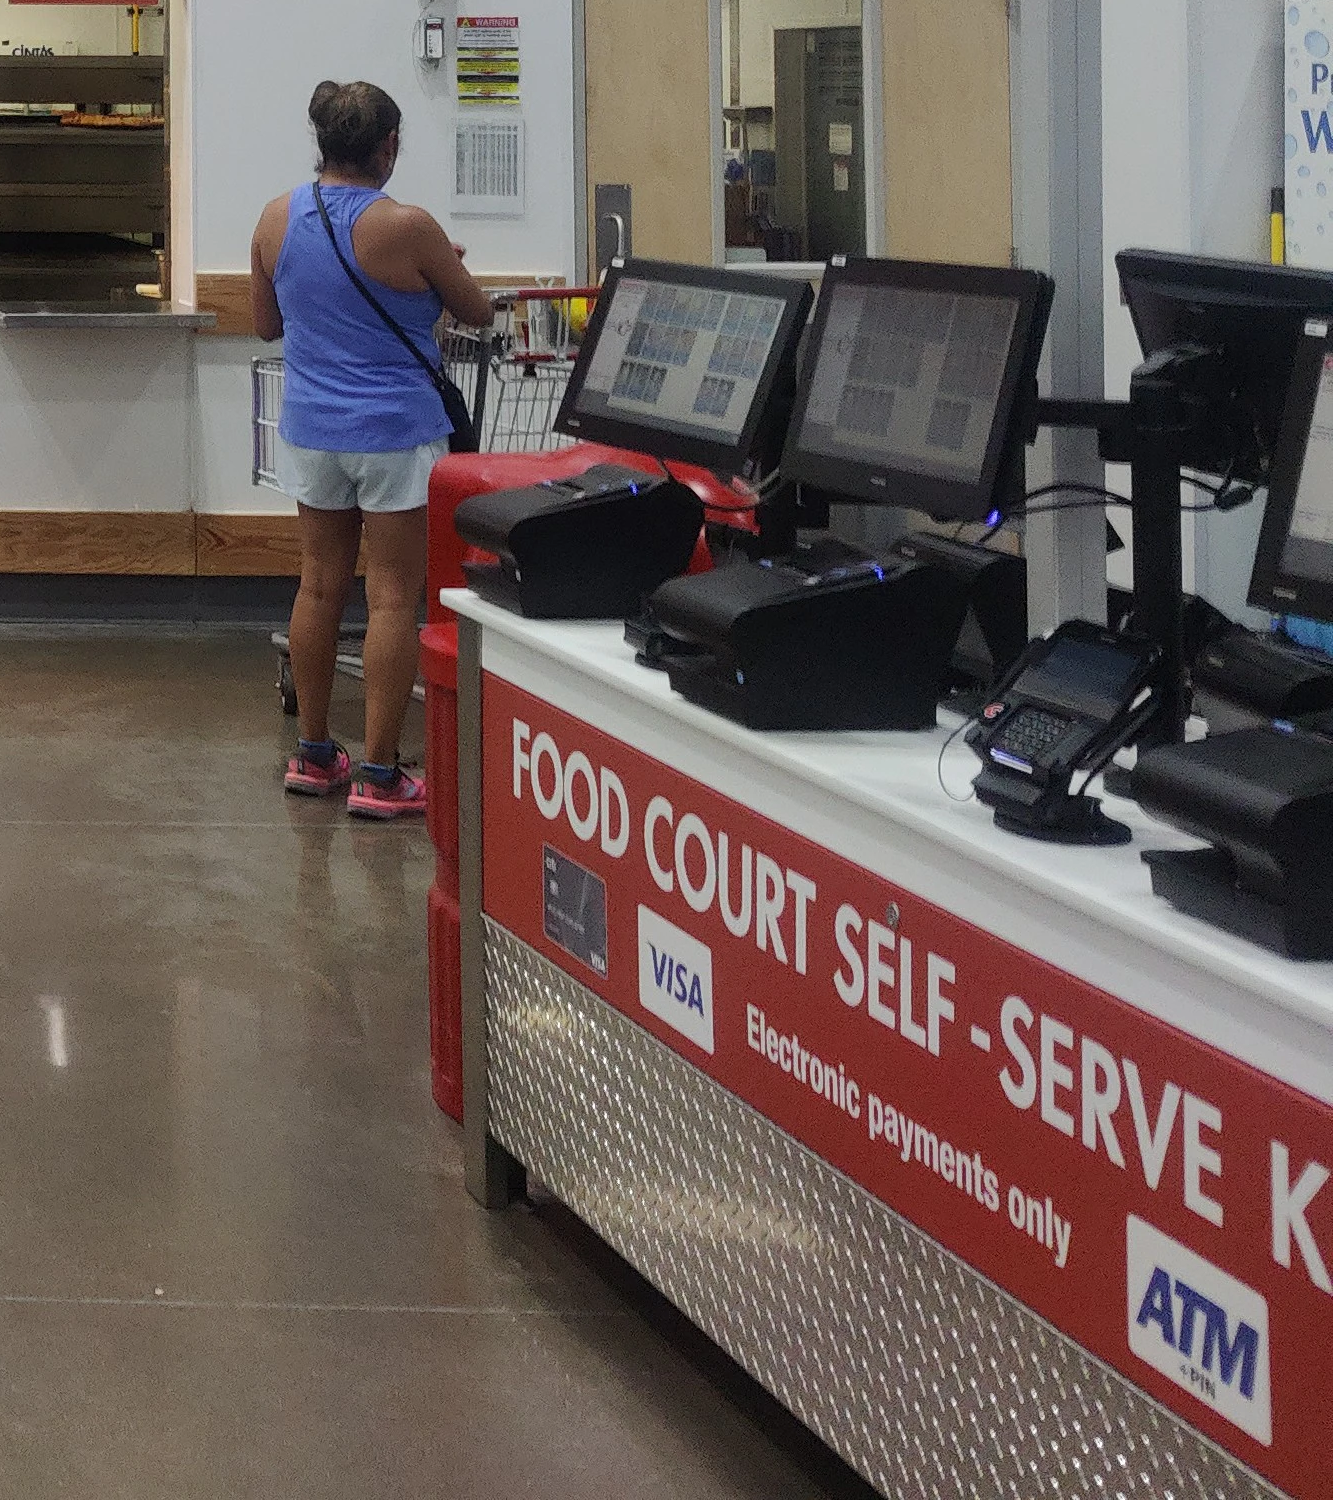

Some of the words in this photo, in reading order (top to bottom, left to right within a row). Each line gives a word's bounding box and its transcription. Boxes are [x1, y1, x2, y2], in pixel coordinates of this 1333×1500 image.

[476, 19, 516, 27] WARNING
[512, 718, 631, 860] FOOD
[643, 796, 817, 976] COURT
[647, 938, 705, 1019] VISA
[745, 1002, 862, 1120] Electronic
[867, 1090, 1000, 1214] payments
[1008, 1184, 1073, 1271] only
[1136, 1266, 1260, 1401] ATM
